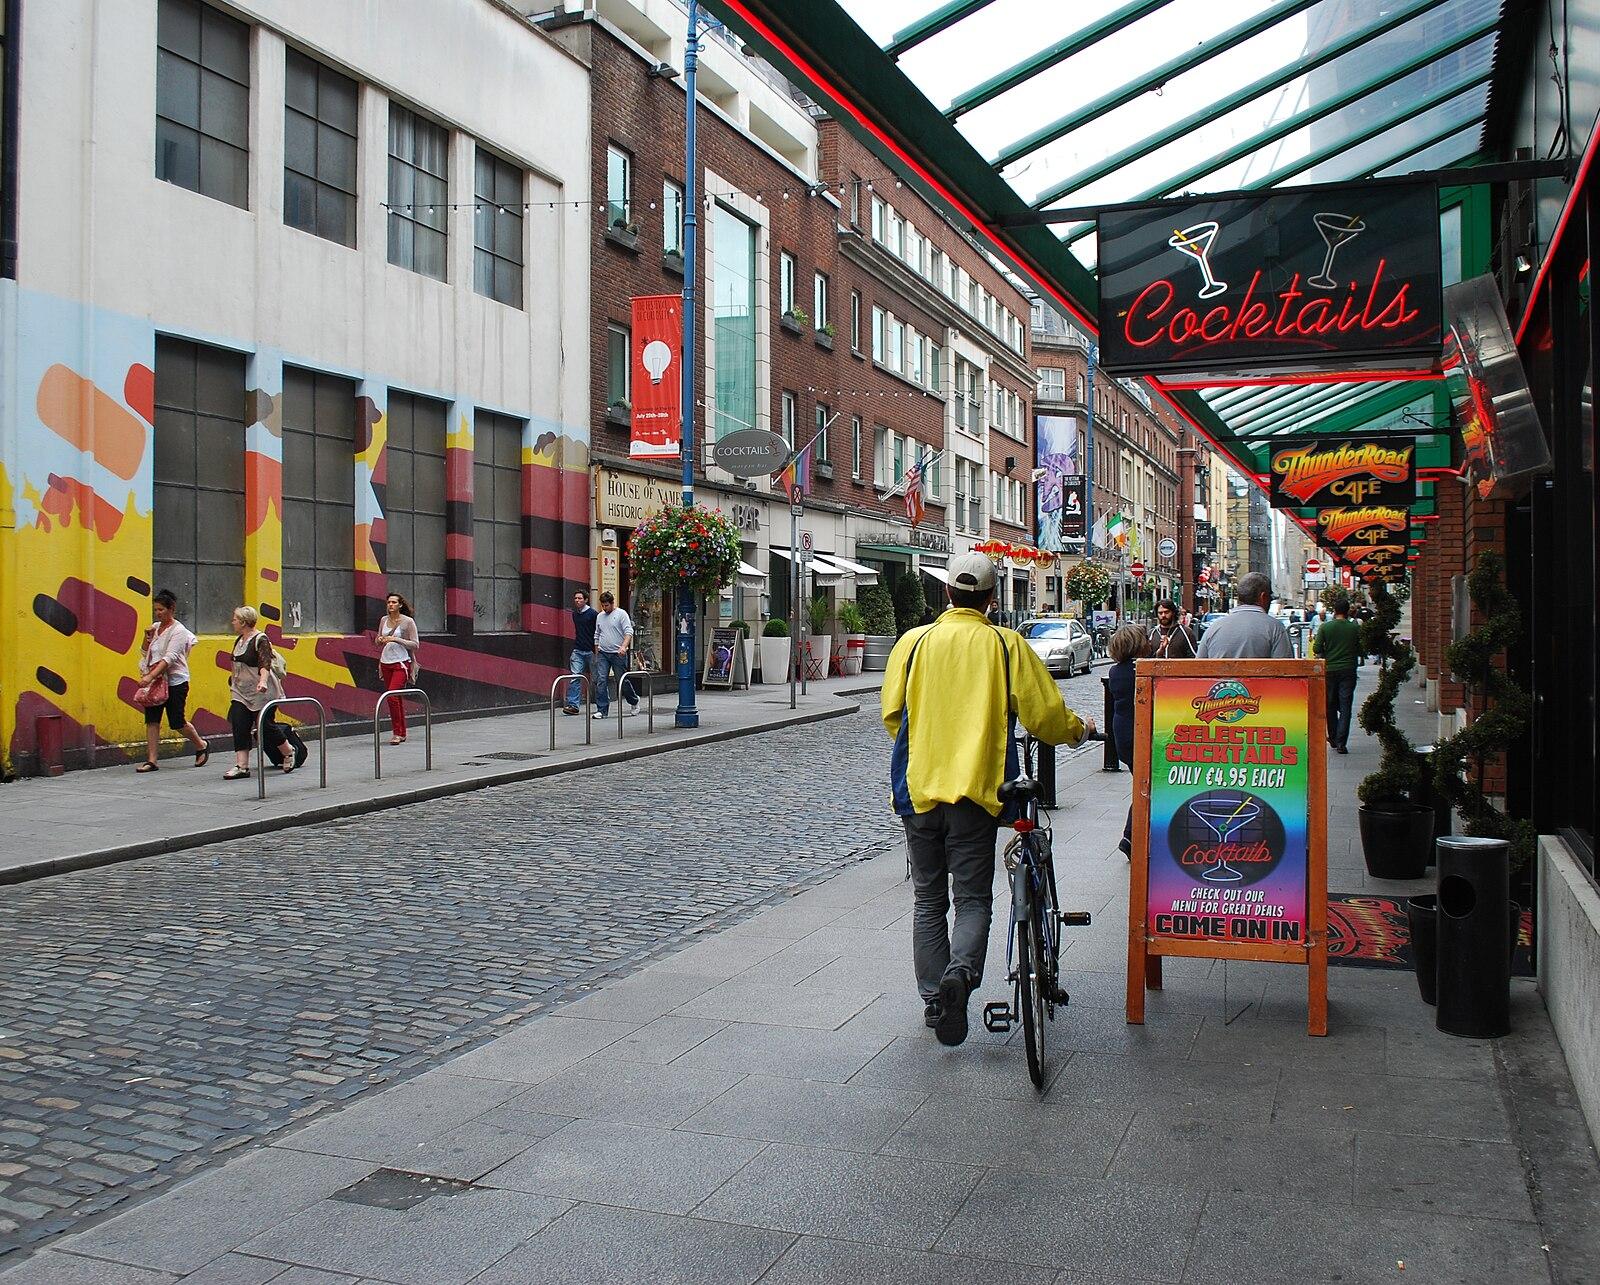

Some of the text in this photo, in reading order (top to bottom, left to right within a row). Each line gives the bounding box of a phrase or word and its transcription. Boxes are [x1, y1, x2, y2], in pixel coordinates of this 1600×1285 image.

[1124, 258, 1419, 346] Cocktails
[717, 446, 770, 456] COCKTAILS
[608, 480, 640, 500] HOUSE
[644, 486, 655, 500] OF
[733, 504, 760, 531] BAR
[1174, 725, 1286, 745] SELECTED
[1166, 743, 1298, 765] COCKTAILS
[1168, 766, 1286, 788] ONLY €4.95 EACH
[1182, 840, 1272, 865] Cocktails
[1190, 888, 1265, 902] CHECK OUT OUR
[1171, 900, 1284, 918] MENU FOR GREAT DEALS
[1155, 914, 1300, 942] COME ON IN
